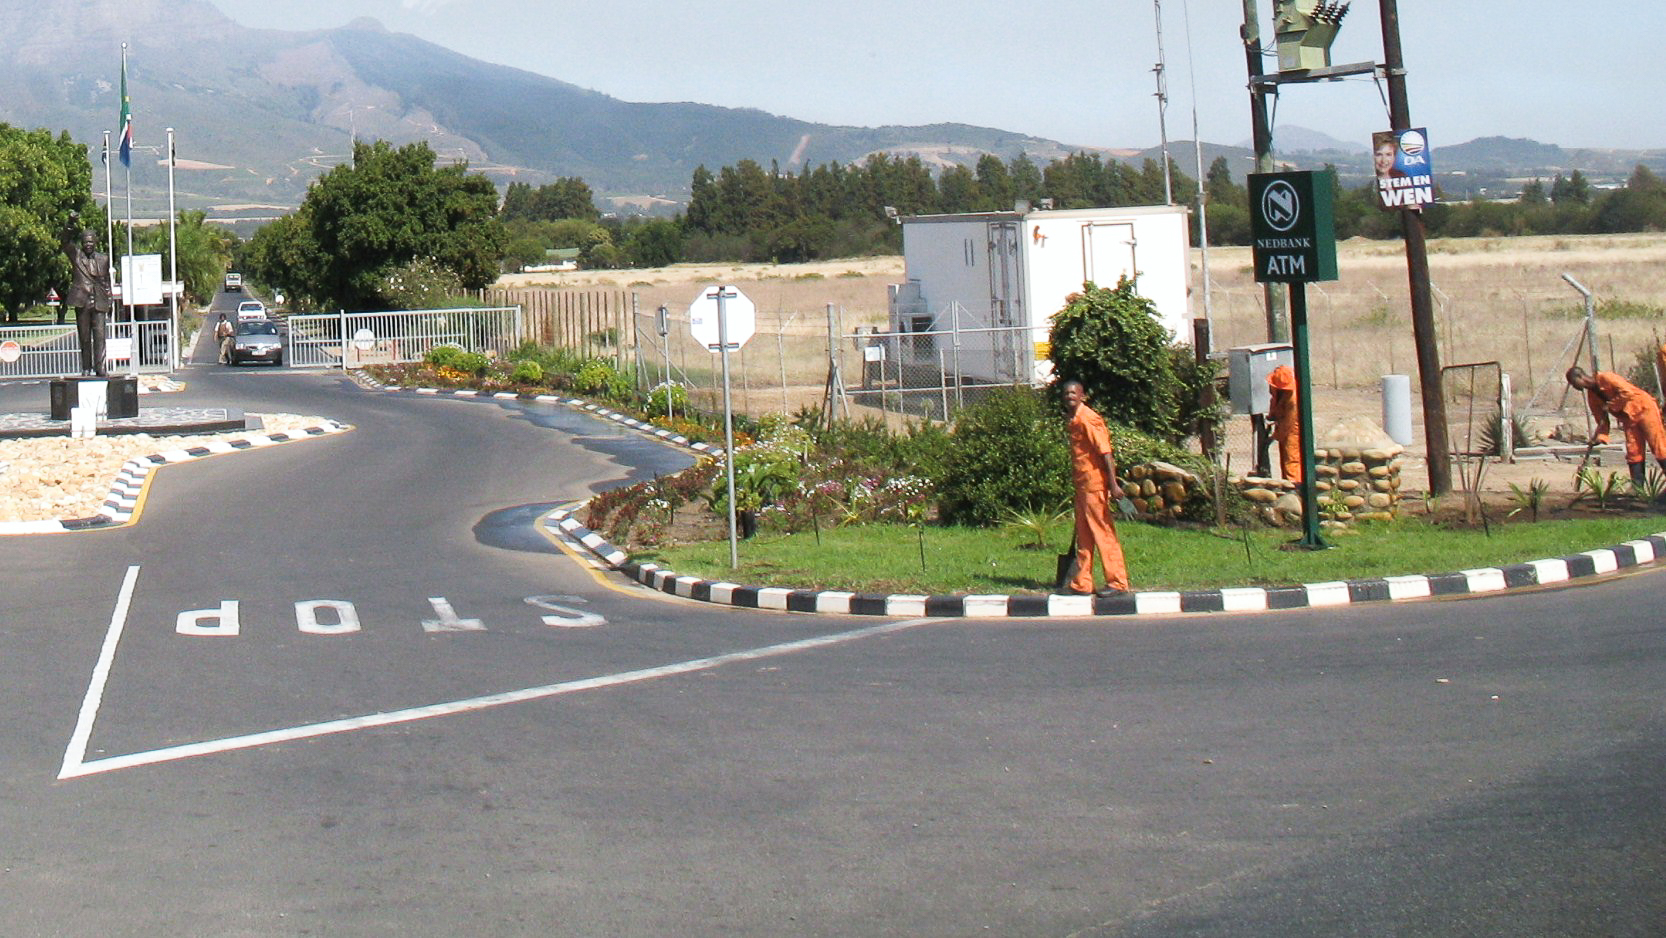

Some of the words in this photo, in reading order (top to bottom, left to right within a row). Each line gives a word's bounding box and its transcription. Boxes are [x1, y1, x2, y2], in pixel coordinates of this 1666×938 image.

[1404, 155, 1426, 166] DA
[1378, 176, 1412, 189] STEM
[1413, 174, 1431, 186] EN
[1380, 186, 1433, 207] WEN
[1257, 237, 1311, 249] NEDBANK
[1267, 255, 1305, 275] ATM
[175, 595, 608, 636] STOP
